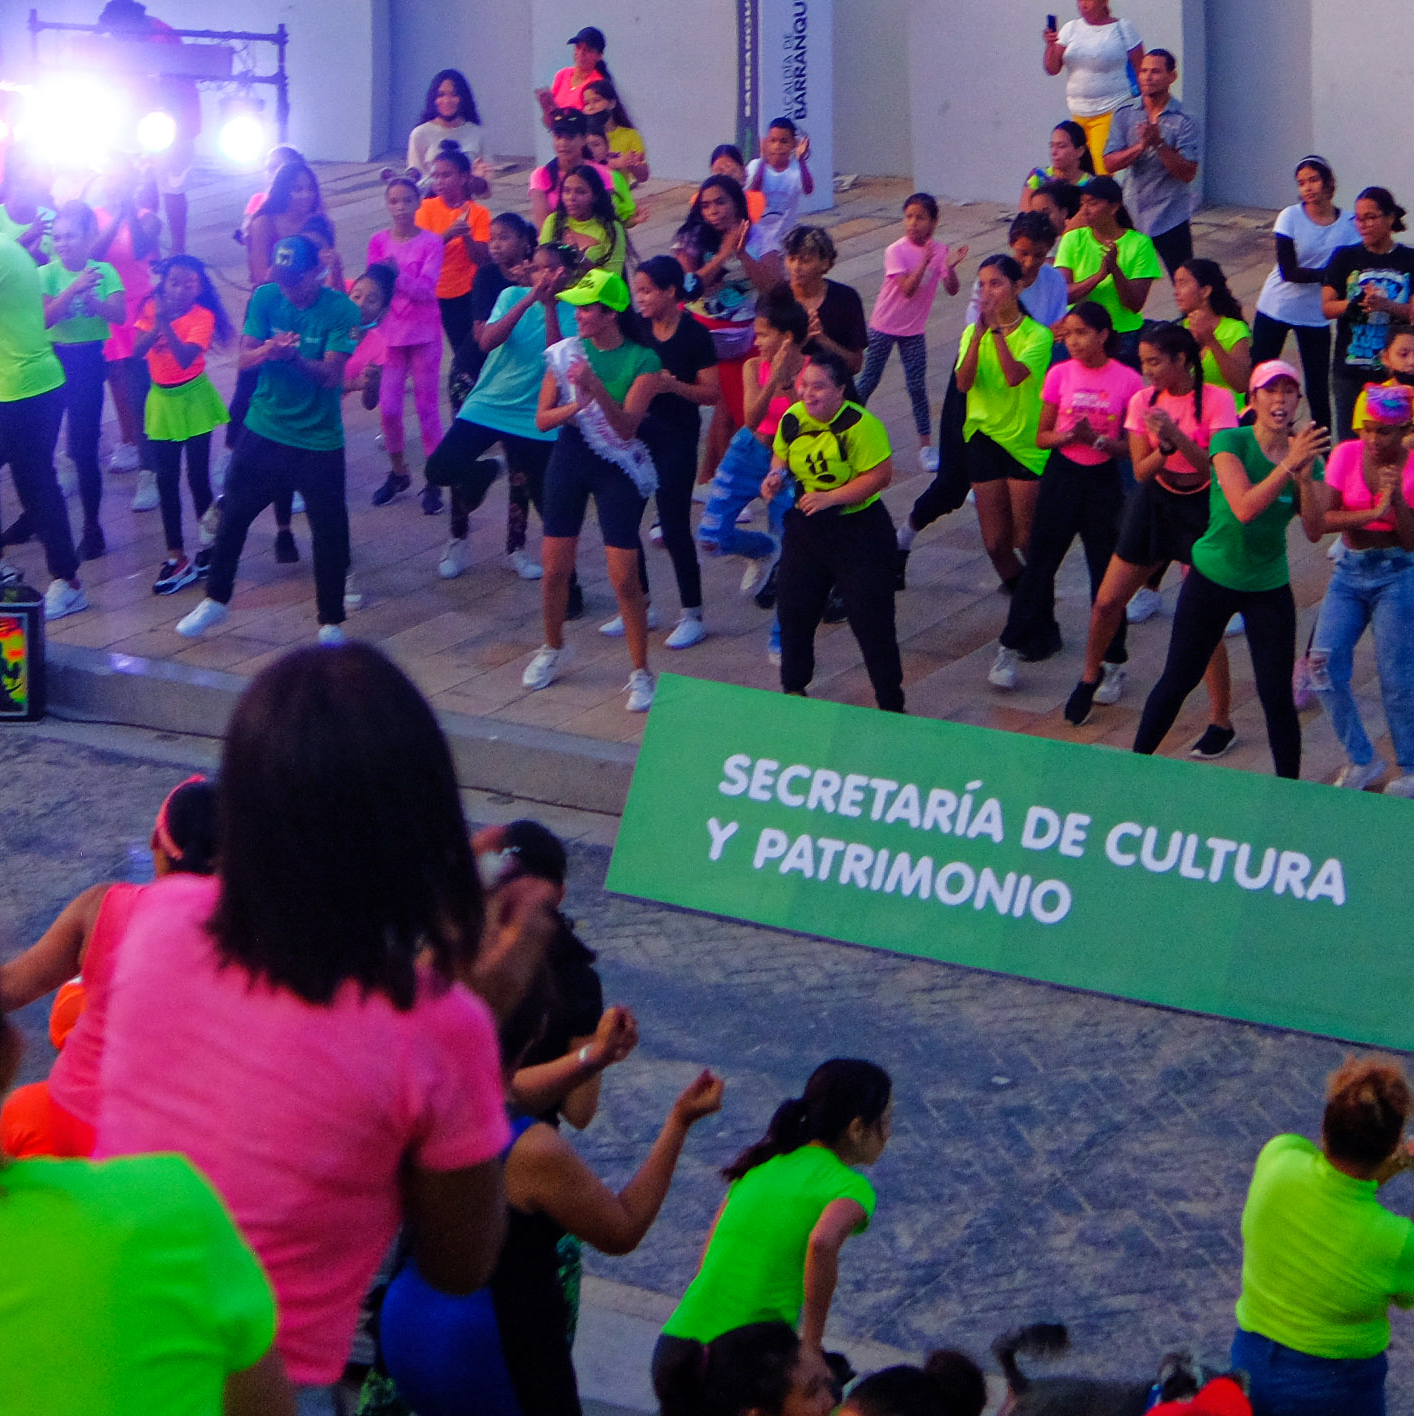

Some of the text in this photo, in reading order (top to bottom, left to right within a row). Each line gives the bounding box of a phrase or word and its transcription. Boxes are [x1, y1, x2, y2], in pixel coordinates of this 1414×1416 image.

[706, 817, 1074, 925] Y PATRIMONIO
[718, 752, 1349, 907] SECRETARÍA DE CULTURA
